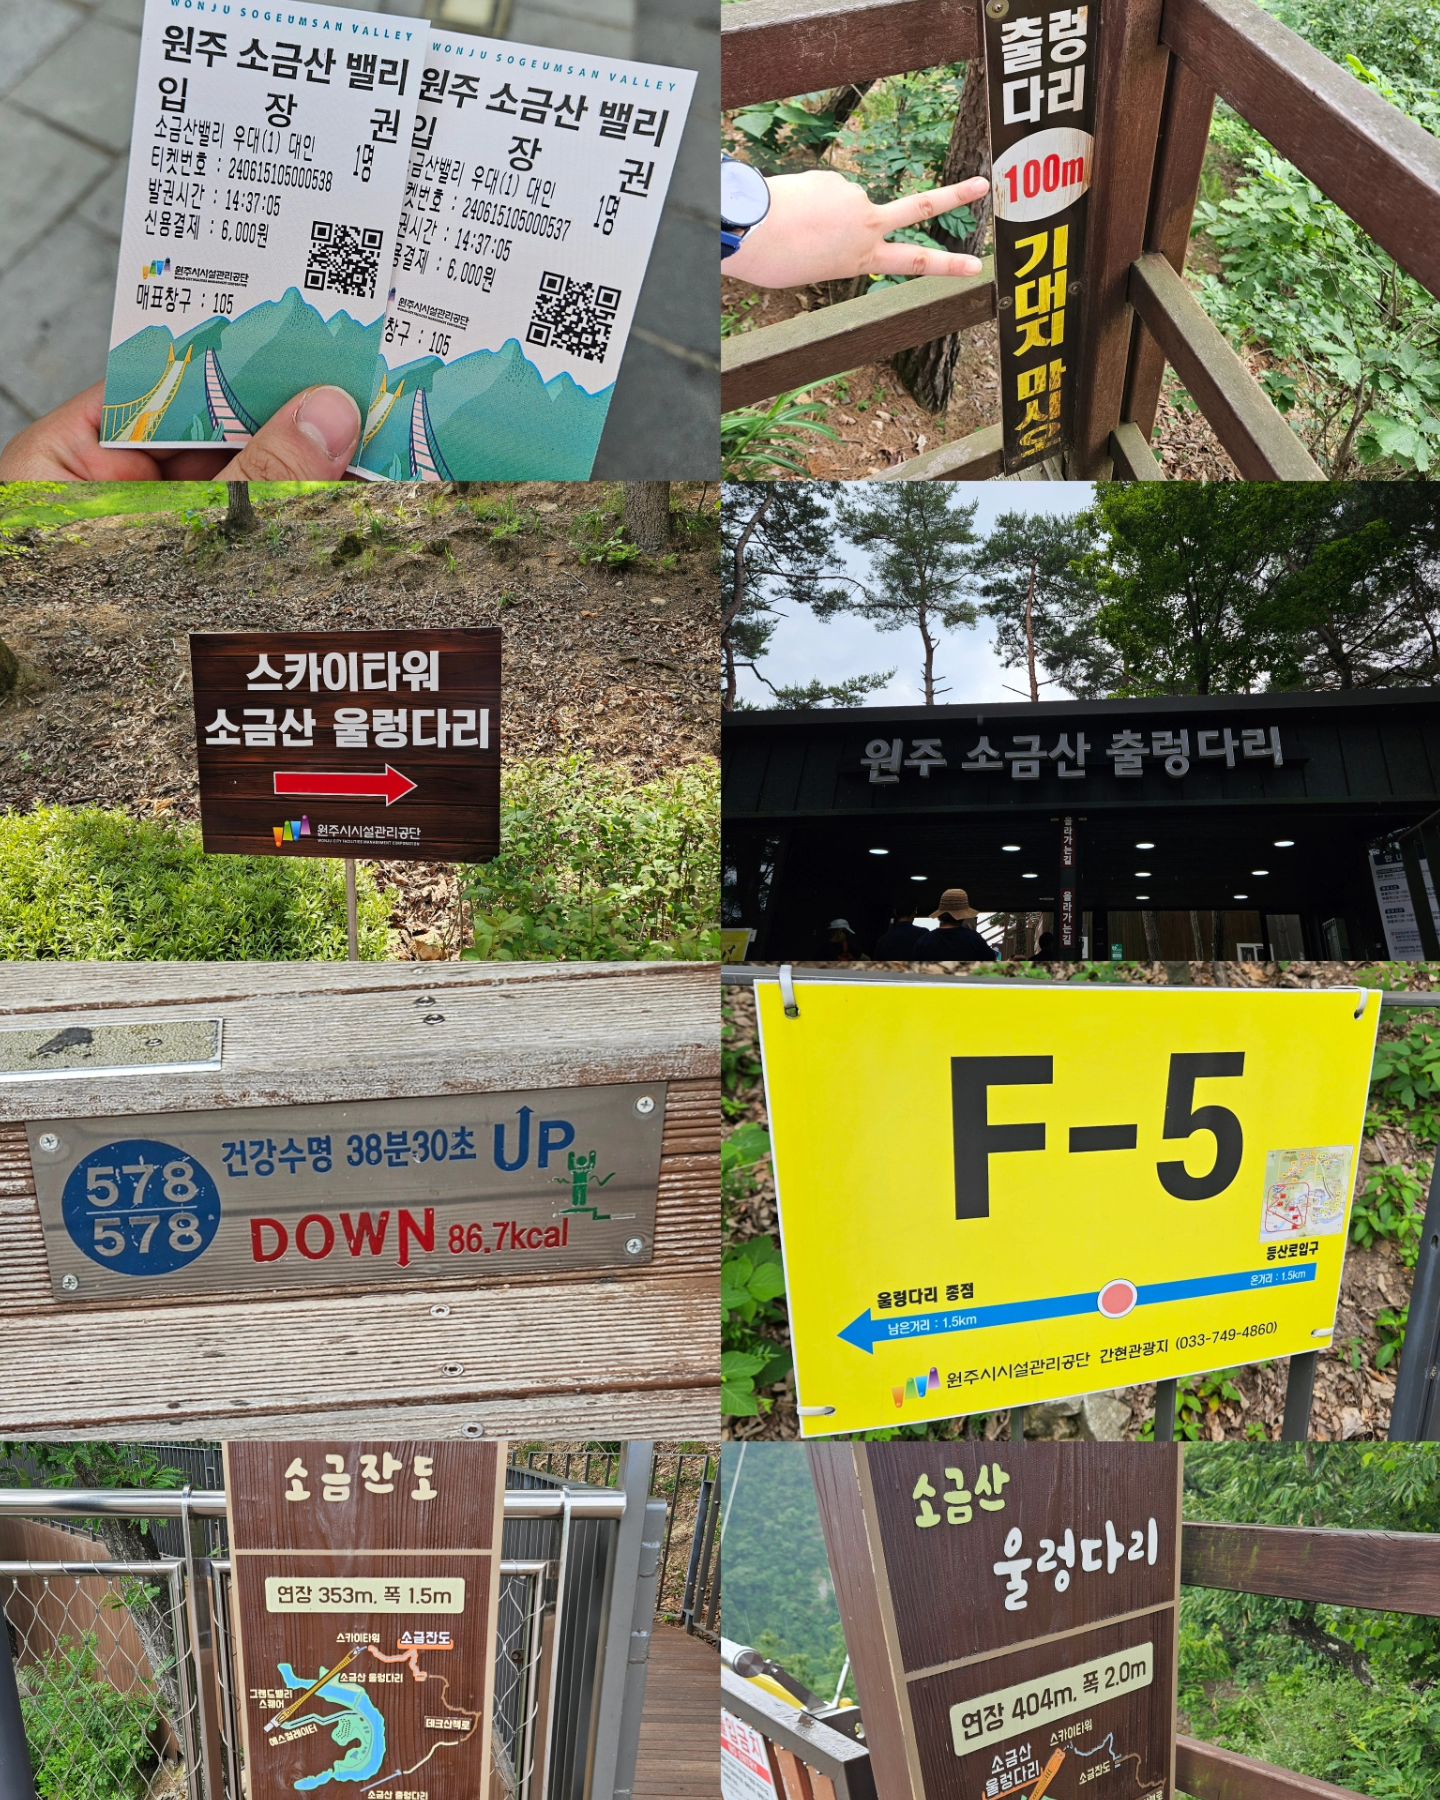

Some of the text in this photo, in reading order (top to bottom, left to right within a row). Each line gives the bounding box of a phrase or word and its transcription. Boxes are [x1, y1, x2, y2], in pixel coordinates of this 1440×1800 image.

[170, 0, 413, 42] WONJU SOGEUMSAN VALLEY
[1001, 5, 1088, 75] 출렁
[162, 24, 410, 96] 원주 소금산 밸리
[432, 42, 677, 92] WONJU SOGEUMSAN VALLEY
[158, 76, 401, 144] 입 장 권
[418, 66, 670, 147] 원주 소금산 밸리
[1002, 64, 1086, 125] 다리
[151, 146, 207, 177] 티켓번호
[227, 157, 333, 192] 240615105000538
[154, 116, 375, 183] 소금산밸리 우대(1) 대인 1명
[411, 114, 655, 197] 입 장 권
[148, 178, 205, 210] 발권시간
[225, 188, 281, 216] 14:37:05
[408, 151, 622, 236] 금산밸리 우대(1) 대인 1명
[1004, 154, 1084, 204] 100m
[144, 209, 200, 240] 신용결제
[221, 219, 270, 249] 6,000원
[462, 197, 572, 242] 240615105000537
[455, 228, 513, 262] 14:37:05
[447, 258, 497, 294] 6,000원
[136, 284, 192, 314] 매표창구
[212, 292, 235, 315] 105
[428, 331, 452, 356] 105
[246, 650, 440, 692] 스카이타워
[204, 708, 490, 749] 소금산 울렁다리
[860, 726, 1284, 784] 원주 소금산 출렁다리
[317, 824, 422, 840] 원주시시설관리공단
[221, 1105, 576, 1178] 건강수명 38분30초 UP
[950, 1051, 1247, 1221] F-5
[86, 1160, 198, 1209] 578
[94, 1211, 202, 1257] 578
[250, 1207, 570, 1270] DOWN 86.7kcal
[1266, 1241, 1319, 1261] 등산로입구
[946, 1282, 974, 1301] 종점
[1249, 1273, 1272, 1287] 온거리
[1282, 1270, 1306, 1281] 1.5km
[888, 1319, 930, 1336] 남은거리
[942, 1315, 977, 1328] 1.5km
[946, 1320, 1278, 1389] 원주시시설관리공단 간현관광지 (033-749-4860)
[284, 1451, 438, 1502] 소금잔도
[912, 1462, 1010, 1529] 소금산
[993, 1517, 1160, 1611] 울렁다리
[277, 1586, 313, 1604] 연장
[384, 1586, 401, 1605] 폭
[408, 1587, 452, 1604] 1.5m
[336, 1632, 381, 1644] 스카이타워
[400, 1631, 451, 1646] 소금잔도
[340, 1672, 366, 1683] 소금산
[961, 1702, 1004, 1741] 연장
[1083, 1670, 1099, 1694] 폭
[1105, 1660, 1146, 1689] 2.0m
[1050, 1718, 1093, 1747] 스카이타워
[985, 1760, 1040, 1797] 울렁다리
[991, 1742, 1032, 1776] 소금산
[1079, 1760, 1112, 1786] 소금잔도
